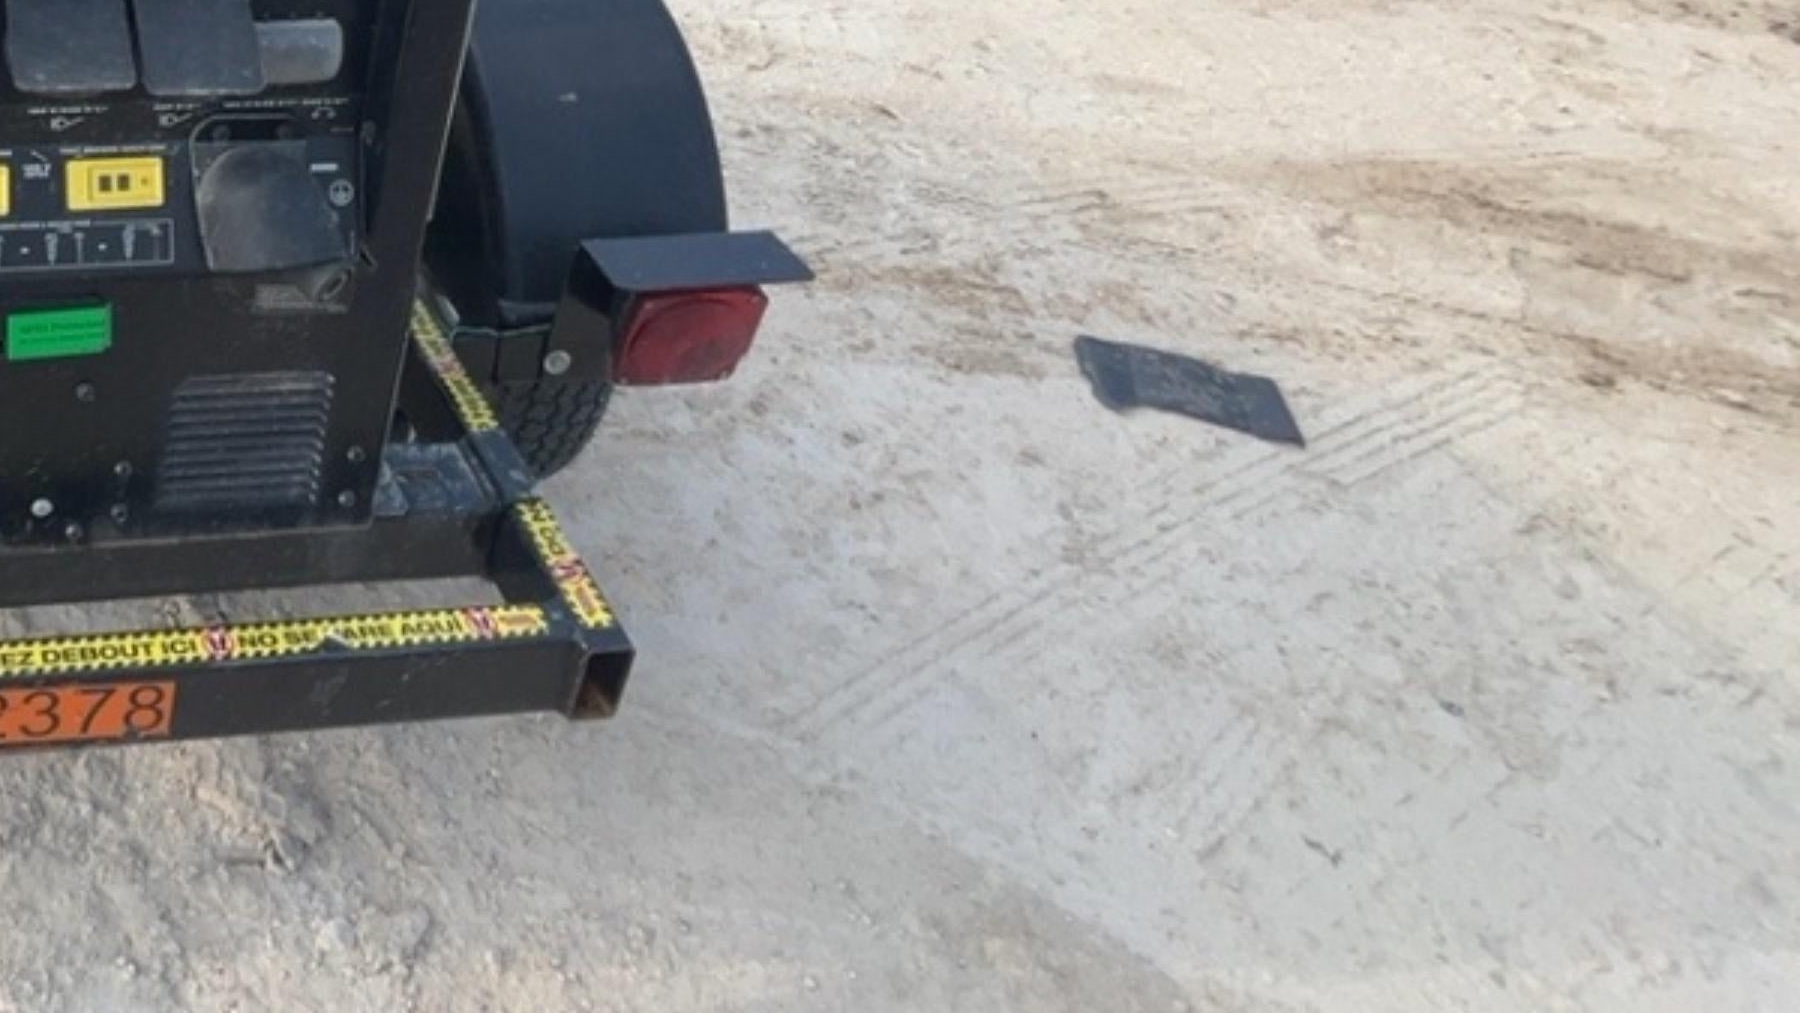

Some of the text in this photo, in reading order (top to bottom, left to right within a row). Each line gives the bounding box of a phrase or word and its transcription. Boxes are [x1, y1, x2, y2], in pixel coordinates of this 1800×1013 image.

[40, 641, 155, 664] DEBOUT
[161, 638, 199, 655] ICI
[238, 631, 278, 649] NO
